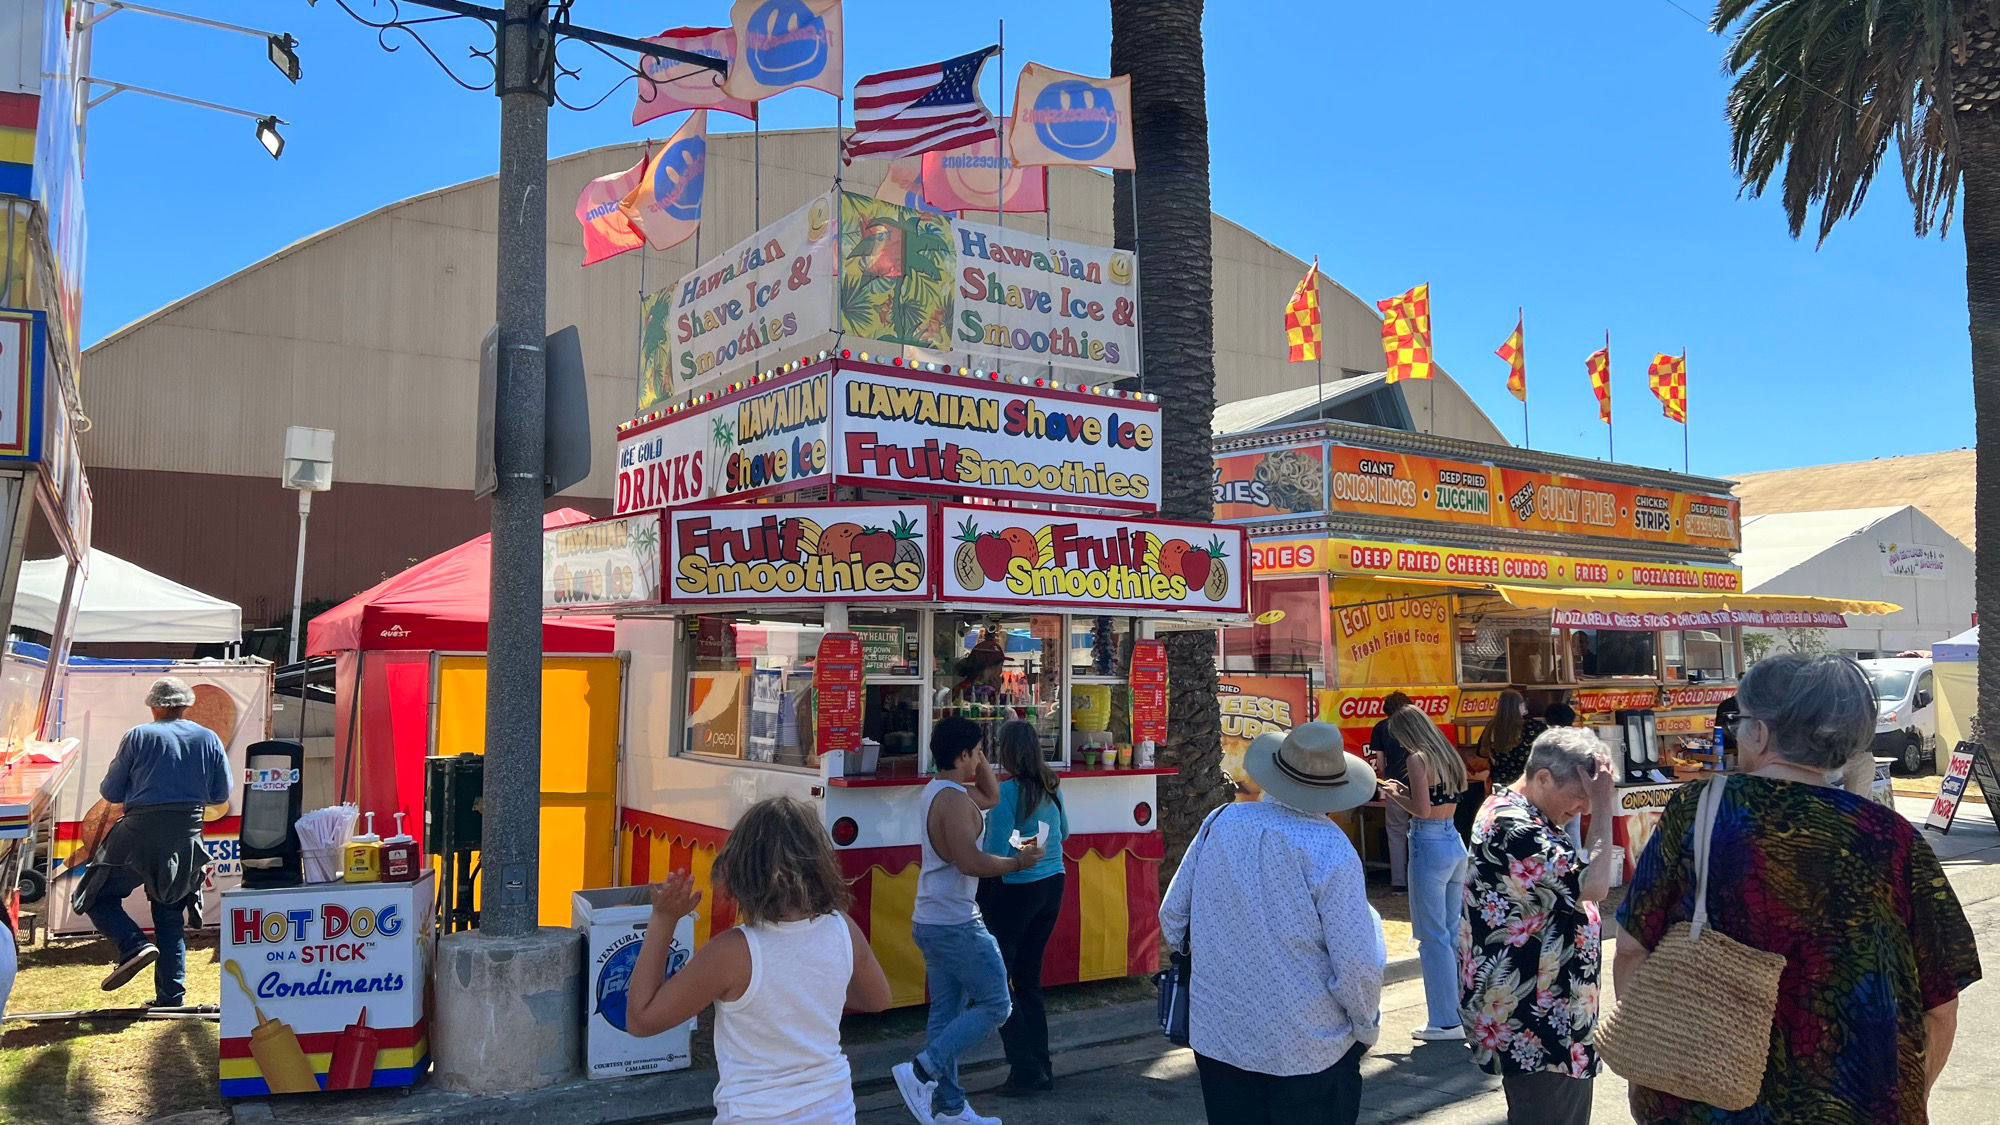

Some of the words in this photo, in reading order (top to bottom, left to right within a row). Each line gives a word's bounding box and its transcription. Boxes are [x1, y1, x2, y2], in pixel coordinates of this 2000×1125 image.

[957, 228, 1102, 284] Hawaiian
[679, 239, 786, 308] Hawaiian
[677, 299, 743, 345] Shave
[746, 279, 781, 313] Ice
[787, 254, 812, 291] &
[959, 266, 1052, 314] Shave
[1059, 286, 1104, 321] Ice
[1112, 296, 1135, 327] &
[680, 311, 797, 381] Smoothies
[957, 309, 1120, 364] Smoothies
[738, 373, 828, 446] HAWAIIAN
[846, 380, 999, 433] HAWAIIAN
[1004, 399, 1102, 446] Shave
[1107, 412, 1154, 451] Ice
[620, 445, 635, 469] ICE
[638, 435, 662, 460] COLD
[791, 436, 828, 480] Ice
[845, 431, 961, 482] Fruit
[956, 448, 1149, 499] Smoothies
[617, 450, 703, 514] DRINKS
[1360, 460, 1395, 476] GIANT
[1440, 470, 1461, 485] DEEP
[1462, 473, 1486, 488] FRIED
[1212, 481, 1270, 506] RIES
[1333, 472, 1379, 504] ONION
[1379, 477, 1416, 507] RINGS
[1435, 487, 1490, 515] ZUCCHINI
[1510, 481, 1534, 511] FRESH
[1636, 495, 1669, 510] CHICKEN
[1520, 502, 1535, 521] CUT
[1537, 485, 1580, 523] CURLY
[1582, 490, 1616, 527] FRIES
[1634, 508, 1671, 533] STRIPS
[1691, 502, 1708, 514] DEEP
[1709, 504, 1728, 517] FRIED
[556, 520, 628, 558] HAWAIIAN
[676, 514, 802, 564] Fruit
[1683, 514, 1712, 536] CHEESE
[1051, 523, 1149, 572] Fruit
[1252, 548, 1313, 568] RIES
[676, 551, 923, 595] Smoothies
[1006, 556, 1188, 600] Smoothies
[1352, 548, 1391, 568] DEEP
[1398, 552, 1439, 571] FRIED
[1446, 556, 1498, 575] CHEESE
[1504, 560, 1547, 579] CURDS
[1575, 565, 1608, 582] FRIES
[1633, 568, 1699, 587] MOZZARELLA
[1703, 573, 1737, 589] STICKS
[1339, 601, 1370, 638] Eat
[1376, 594, 1394, 622] at
[1401, 594, 1446, 623] Joe's
[1556, 612, 1613, 626] MOZZARELLA
[1614, 615, 1641, 627] CHEESE
[1644, 615, 1669, 627] STICKS
[1677, 612, 1711, 626] CHICKEN
[869, 632, 898, 641] HEALTHY
[1351, 635, 1381, 662] Fresh
[1384, 629, 1410, 648] Fried
[1415, 629, 1440, 645] Food
[1462, 699, 1477, 711] Eat
[1479, 699, 1488, 710] at
[1678, 690, 1704, 702] COLD
[712, 730, 736, 749] pepsi
[245, 770, 269, 782] HOT
[270, 769, 299, 782] DOG
[1949, 755, 1971, 777] MORE
[1622, 790, 1653, 809] ONION
[1932, 796, 1954, 819] INSIDE
[218, 863, 231, 873] ON
[231, 908, 313, 945] HOT
[321, 903, 403, 940] DOG
[266, 951, 284, 961] ON
[287, 951, 296, 960] A
[597, 932, 639, 965] VENTURA
[257, 968, 404, 999] Condiments
[594, 1061, 623, 1069] COURTESY
[625, 1063, 658, 1072] CAMARILLO
